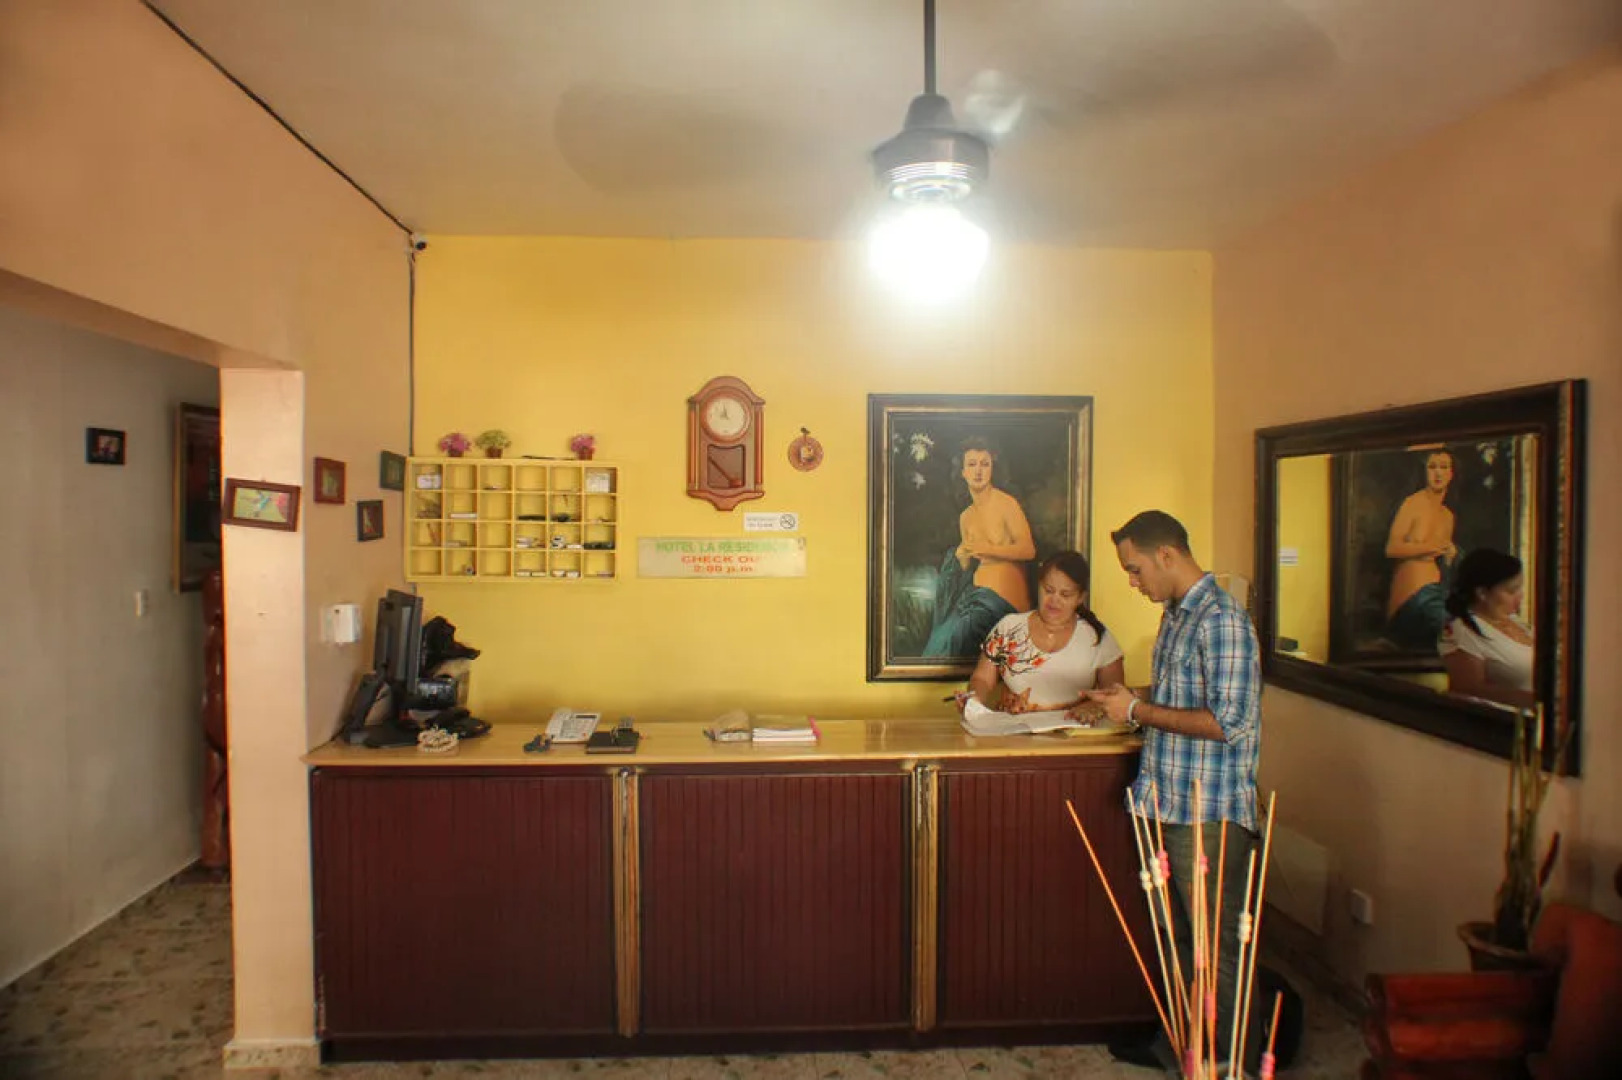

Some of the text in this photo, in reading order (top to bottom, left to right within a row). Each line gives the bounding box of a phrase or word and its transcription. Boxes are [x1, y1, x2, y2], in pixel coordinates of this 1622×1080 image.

[655, 541, 694, 553] HOTEL
[699, 541, 716, 553] LA
[681, 555, 762, 564] CHECK OU
